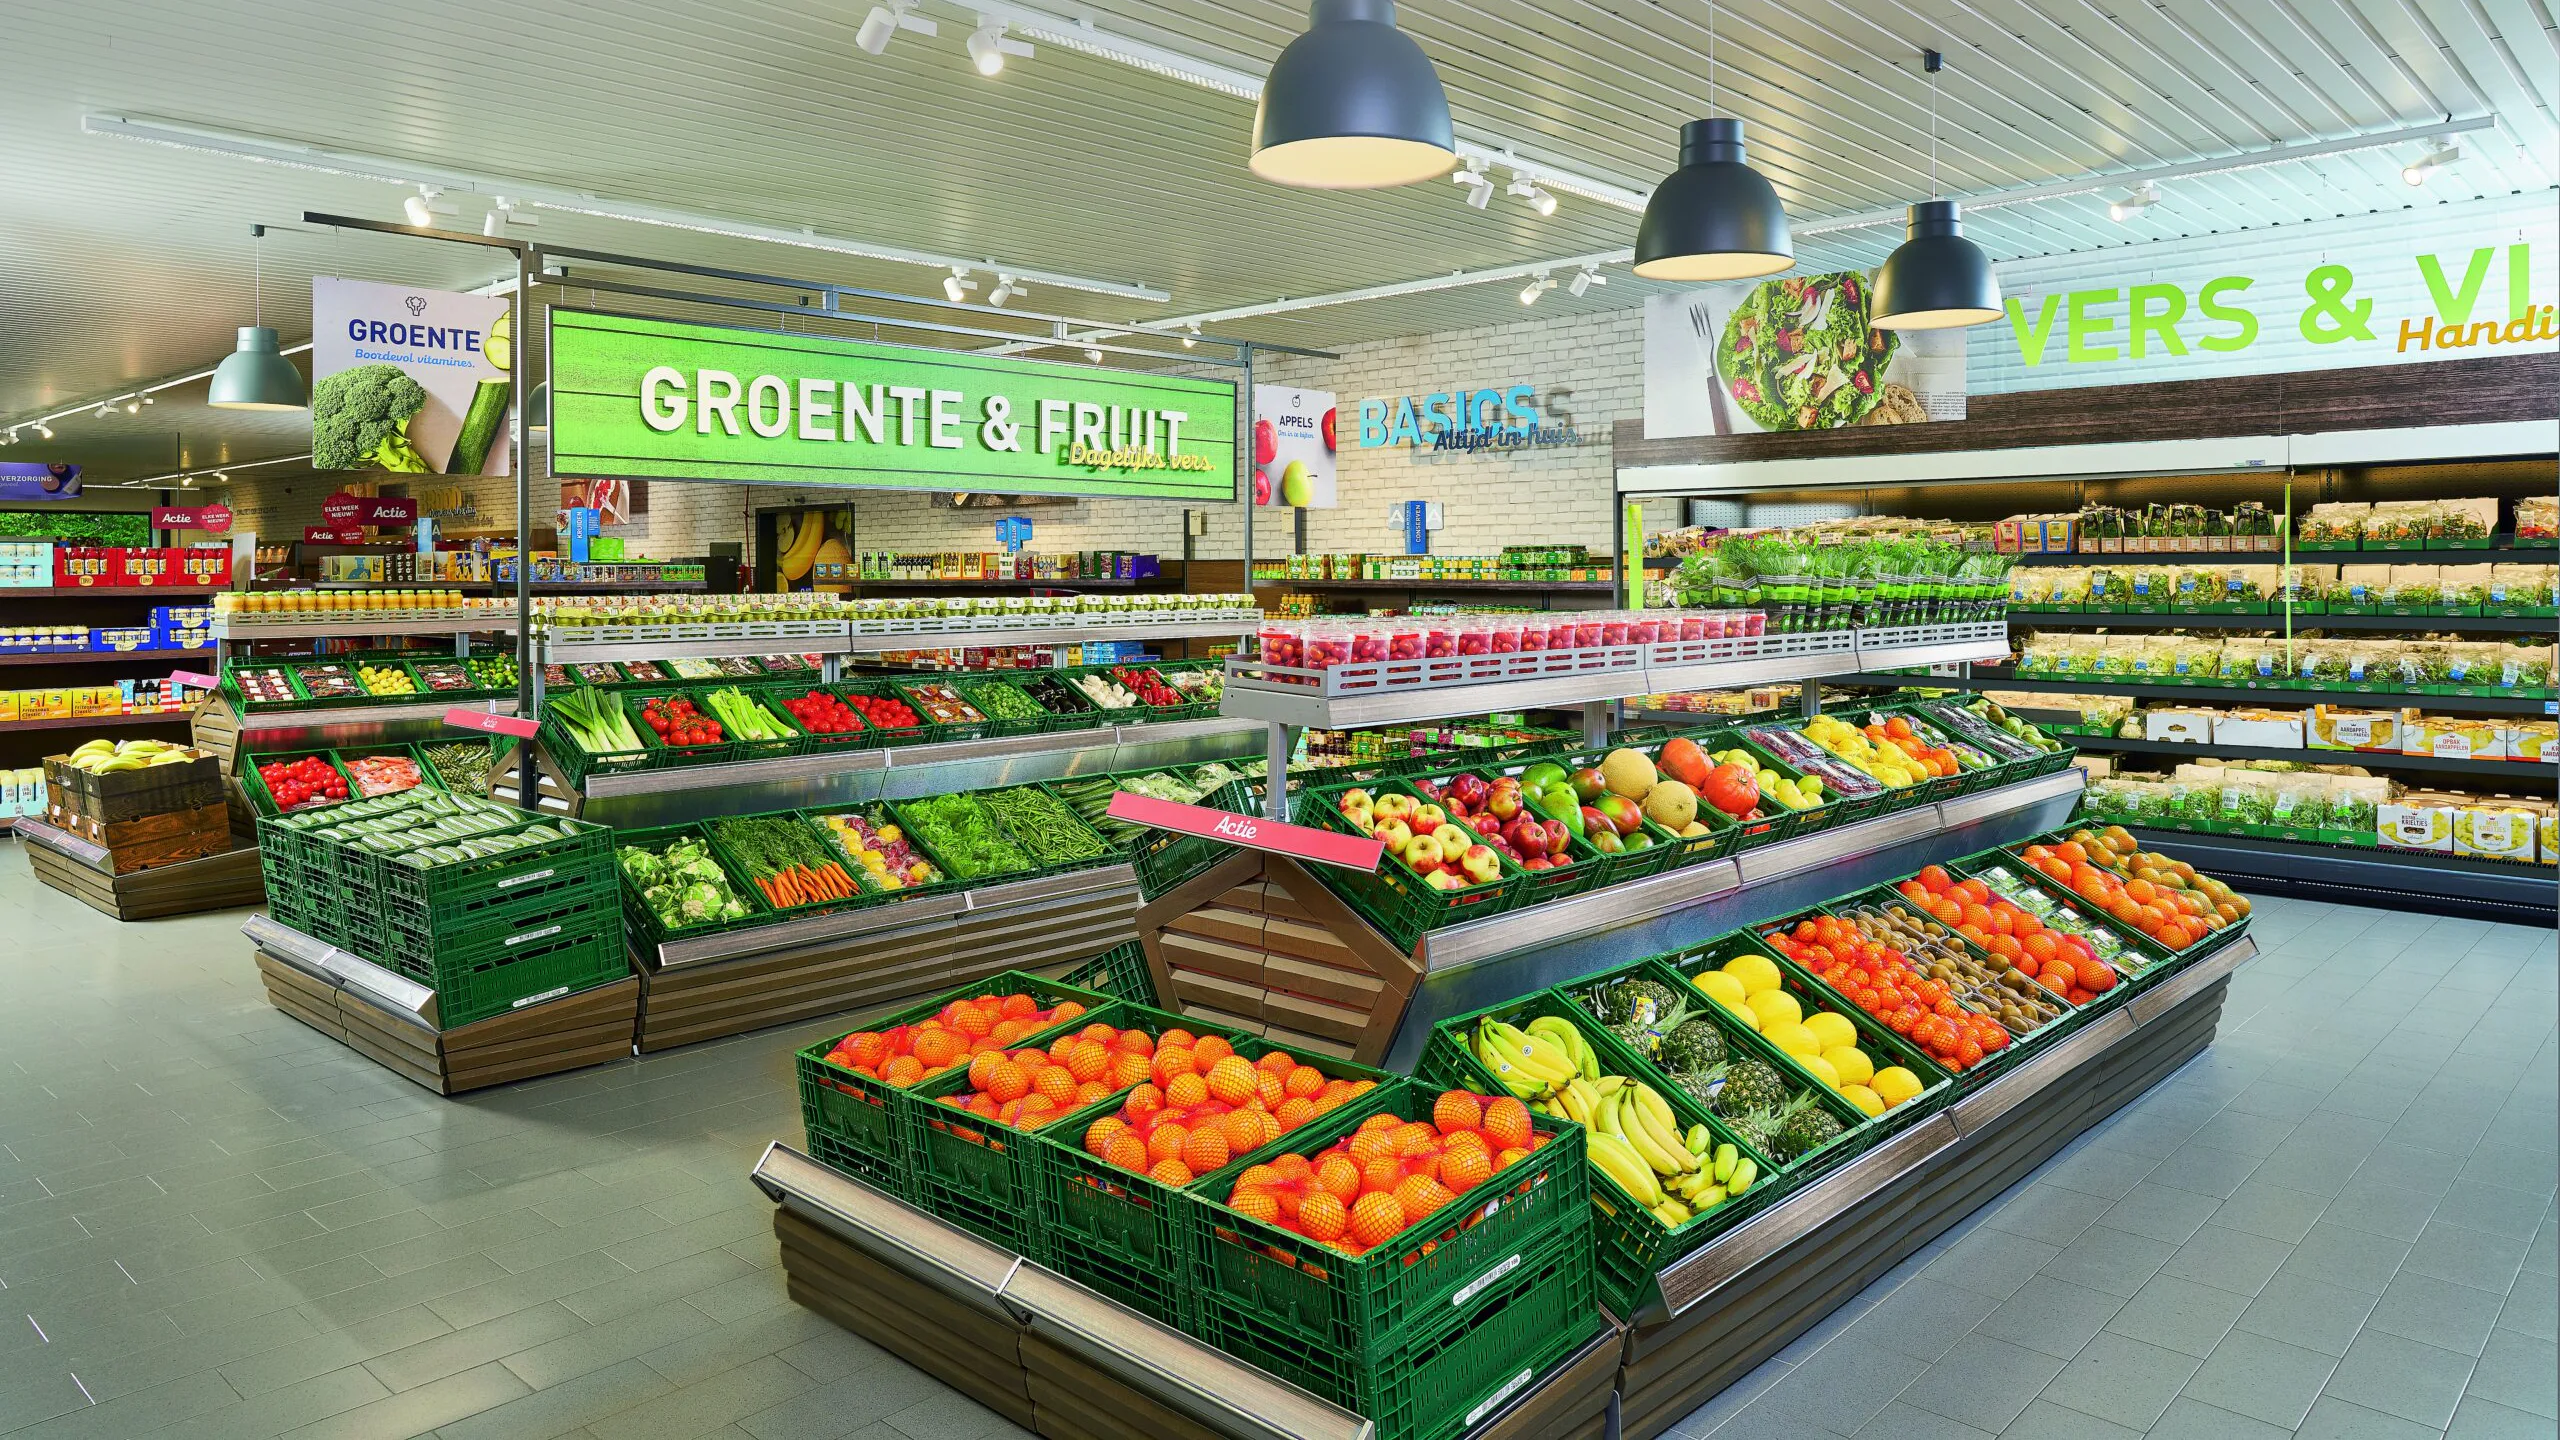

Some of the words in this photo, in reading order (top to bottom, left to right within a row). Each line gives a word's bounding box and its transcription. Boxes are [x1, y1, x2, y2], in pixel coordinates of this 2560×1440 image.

[2006, 275, 2259, 367] VERS
[2299, 264, 2377, 345] &
[349, 319, 481, 352] GROENTE
[355, 349, 414, 363] Boordevol
[417, 354, 475, 368] vitamines.
[640, 366, 963, 449] GROENTE
[981, 395, 1023, 452] &
[1040, 399, 1188, 454] FRUIT
[1359, 385, 1538, 448] BASICS
[1280, 415, 1313, 428] APPELS
[1434, 428, 1492, 454] Altijd
[1497, 426, 1522, 447] in
[1527, 422, 1583, 445] huis.
[1070, 442, 1166, 471] Dagelijks
[1170, 450, 1216, 471] vers.
[162, 513, 192, 523] Actie
[373, 506, 408, 518] Actie
[311, 531, 335, 540] Actie
[432, 524, 441, 535] A
[481, 716, 498, 728] Actie
[1213, 814, 1257, 839] Actie
[2401, 819, 2428, 827] KRIELTJES
